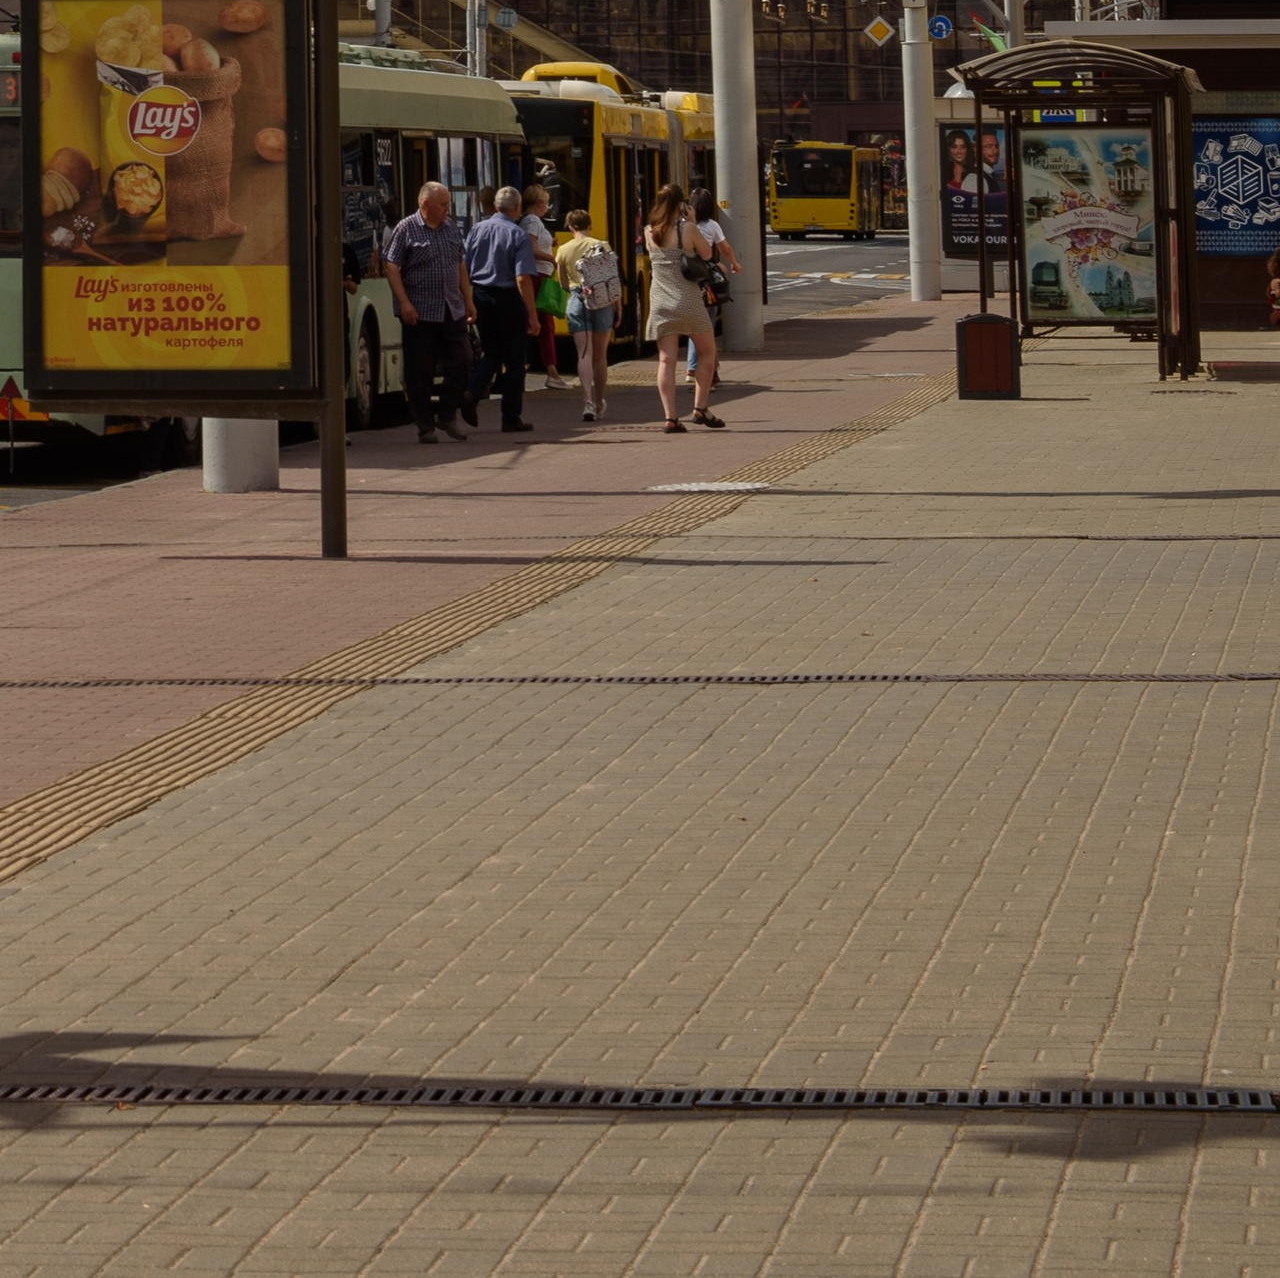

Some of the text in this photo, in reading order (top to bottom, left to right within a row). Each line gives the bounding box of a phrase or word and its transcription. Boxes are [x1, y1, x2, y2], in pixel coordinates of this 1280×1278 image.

[133, 102, 197, 140] Lay's
[74, 275, 214, 303] Lay's изготовлены
[127, 293, 227, 312] из 100%
[87, 316, 261, 337] натурального
[165, 335, 244, 350] картофеля
